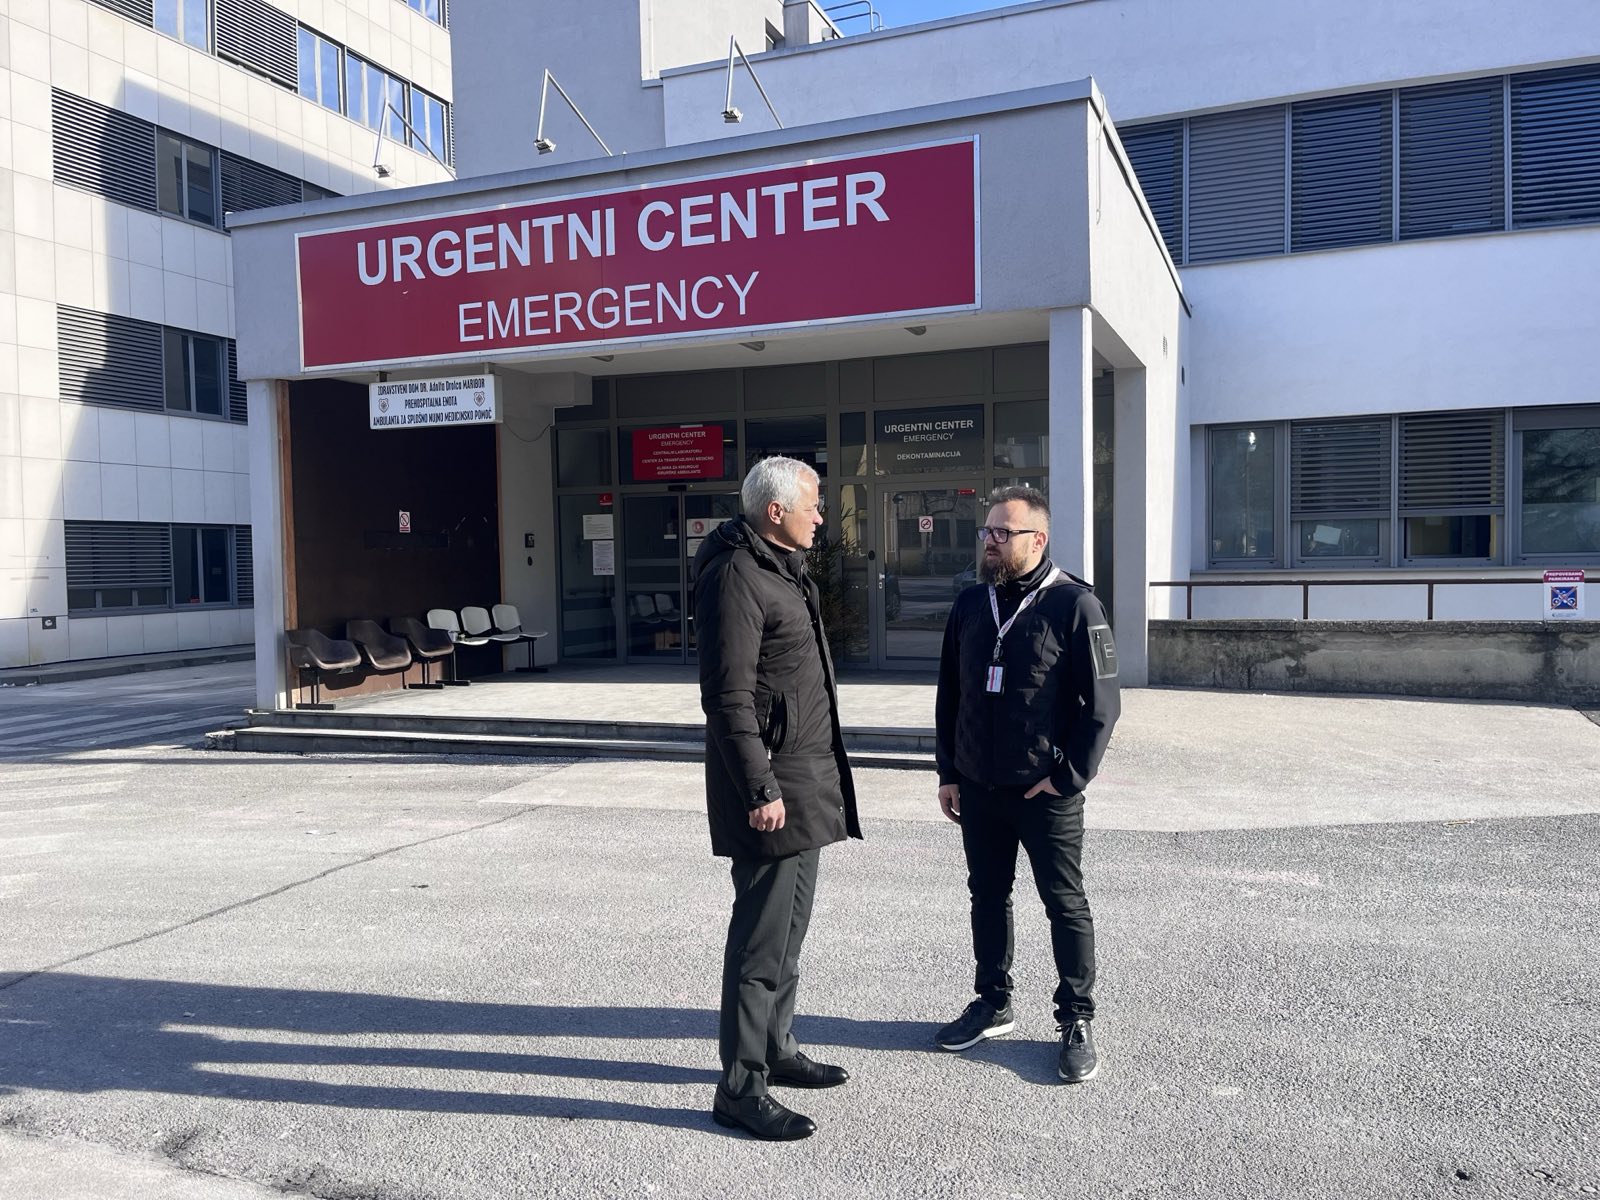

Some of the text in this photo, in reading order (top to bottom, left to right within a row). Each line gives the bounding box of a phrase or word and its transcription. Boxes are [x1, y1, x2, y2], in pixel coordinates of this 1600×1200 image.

[355, 170, 890, 286] URGENTNI CENTER
[458, 270, 760, 343] EMERGENCY
[377, 384, 407, 396] ZDRAVSTVENI
[408, 383, 419, 394] DOM
[420, 382, 428, 393] DR.
[462, 378, 485, 389] MARIBOR
[404, 396, 458, 409] PREHOSPITALNA ENOTA
[373, 416, 400, 426] AMBULANTA
[400, 414, 406, 424] ZA
[407, 412, 428, 424] SPLOŠNO
[428, 412, 444, 423] NUJNO
[444, 410, 474, 422] MEDICINSKO
[884, 420, 974, 433] URGENTNI CENTER
[648, 432, 680, 440] URGENTNI
[904, 433, 954, 442] EMERGENCY
[896, 451, 961, 460] DEKONTAMINACIJA
